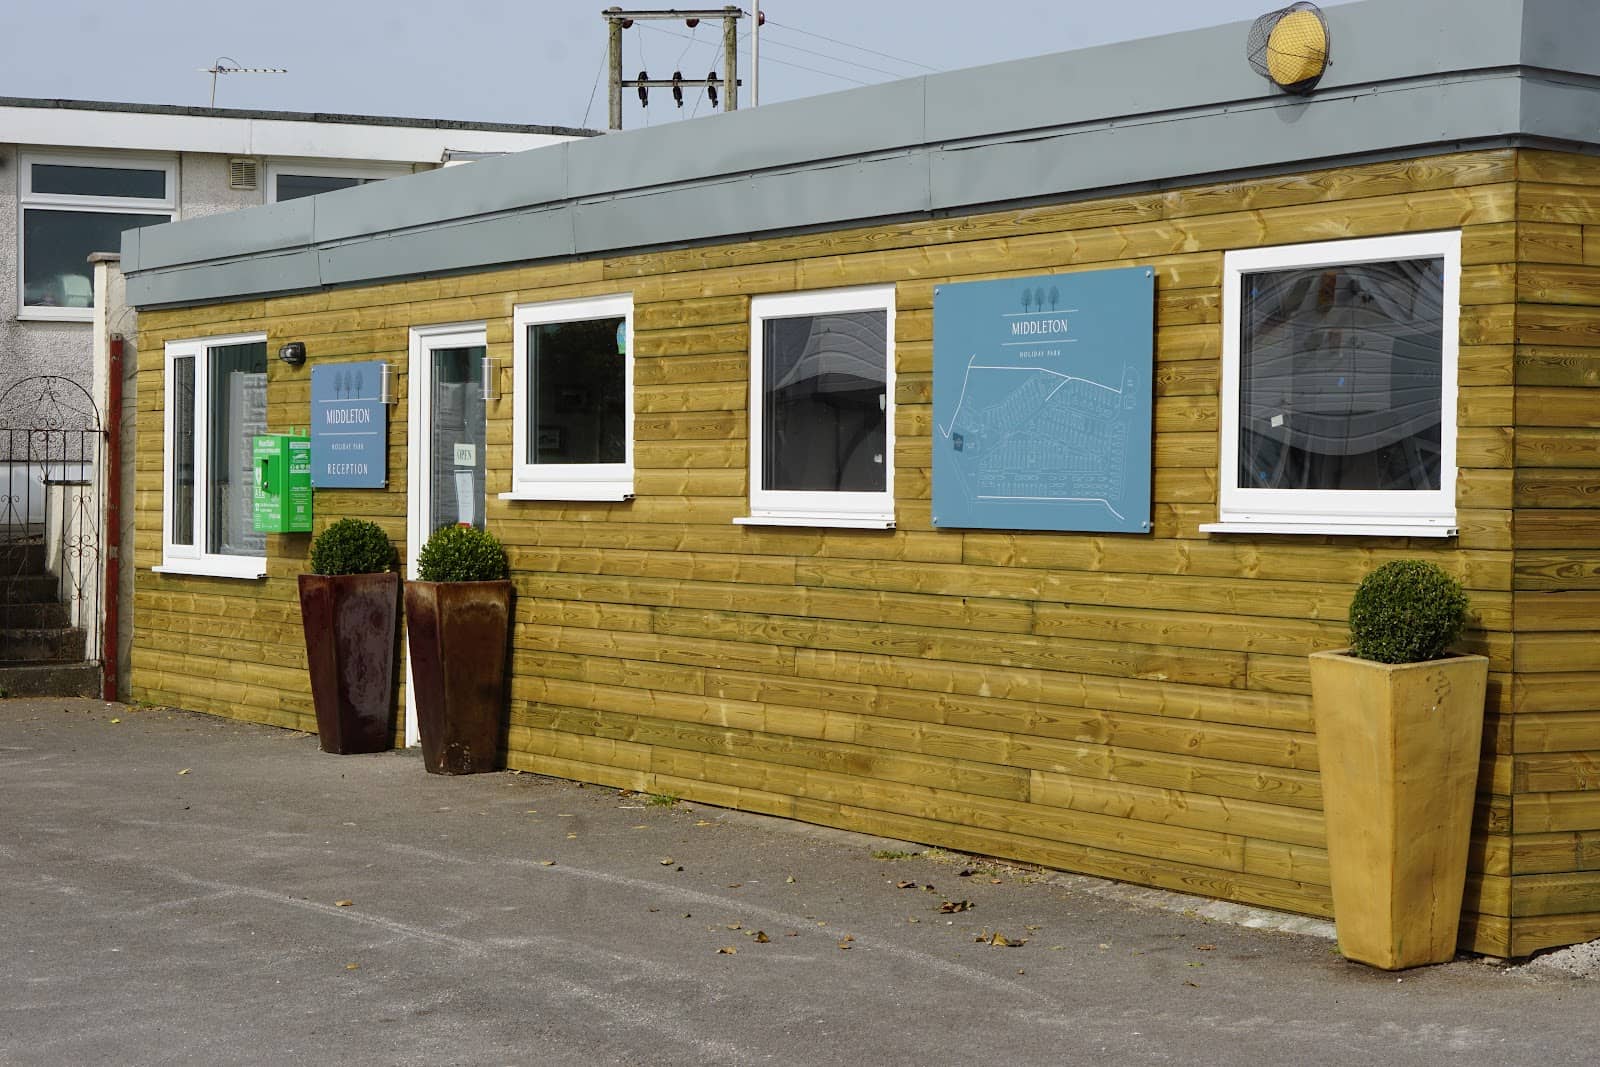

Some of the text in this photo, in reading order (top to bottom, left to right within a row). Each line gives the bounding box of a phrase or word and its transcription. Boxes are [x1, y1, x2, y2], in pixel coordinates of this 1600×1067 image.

[1012, 319, 1068, 336] MIDDLETON
[1019, 349, 1061, 359] HOLIDAY PARK
[326, 408, 370, 424] MIDDLETON
[456, 448, 472, 461] OPEN
[327, 463, 368, 475] RECEPTION
